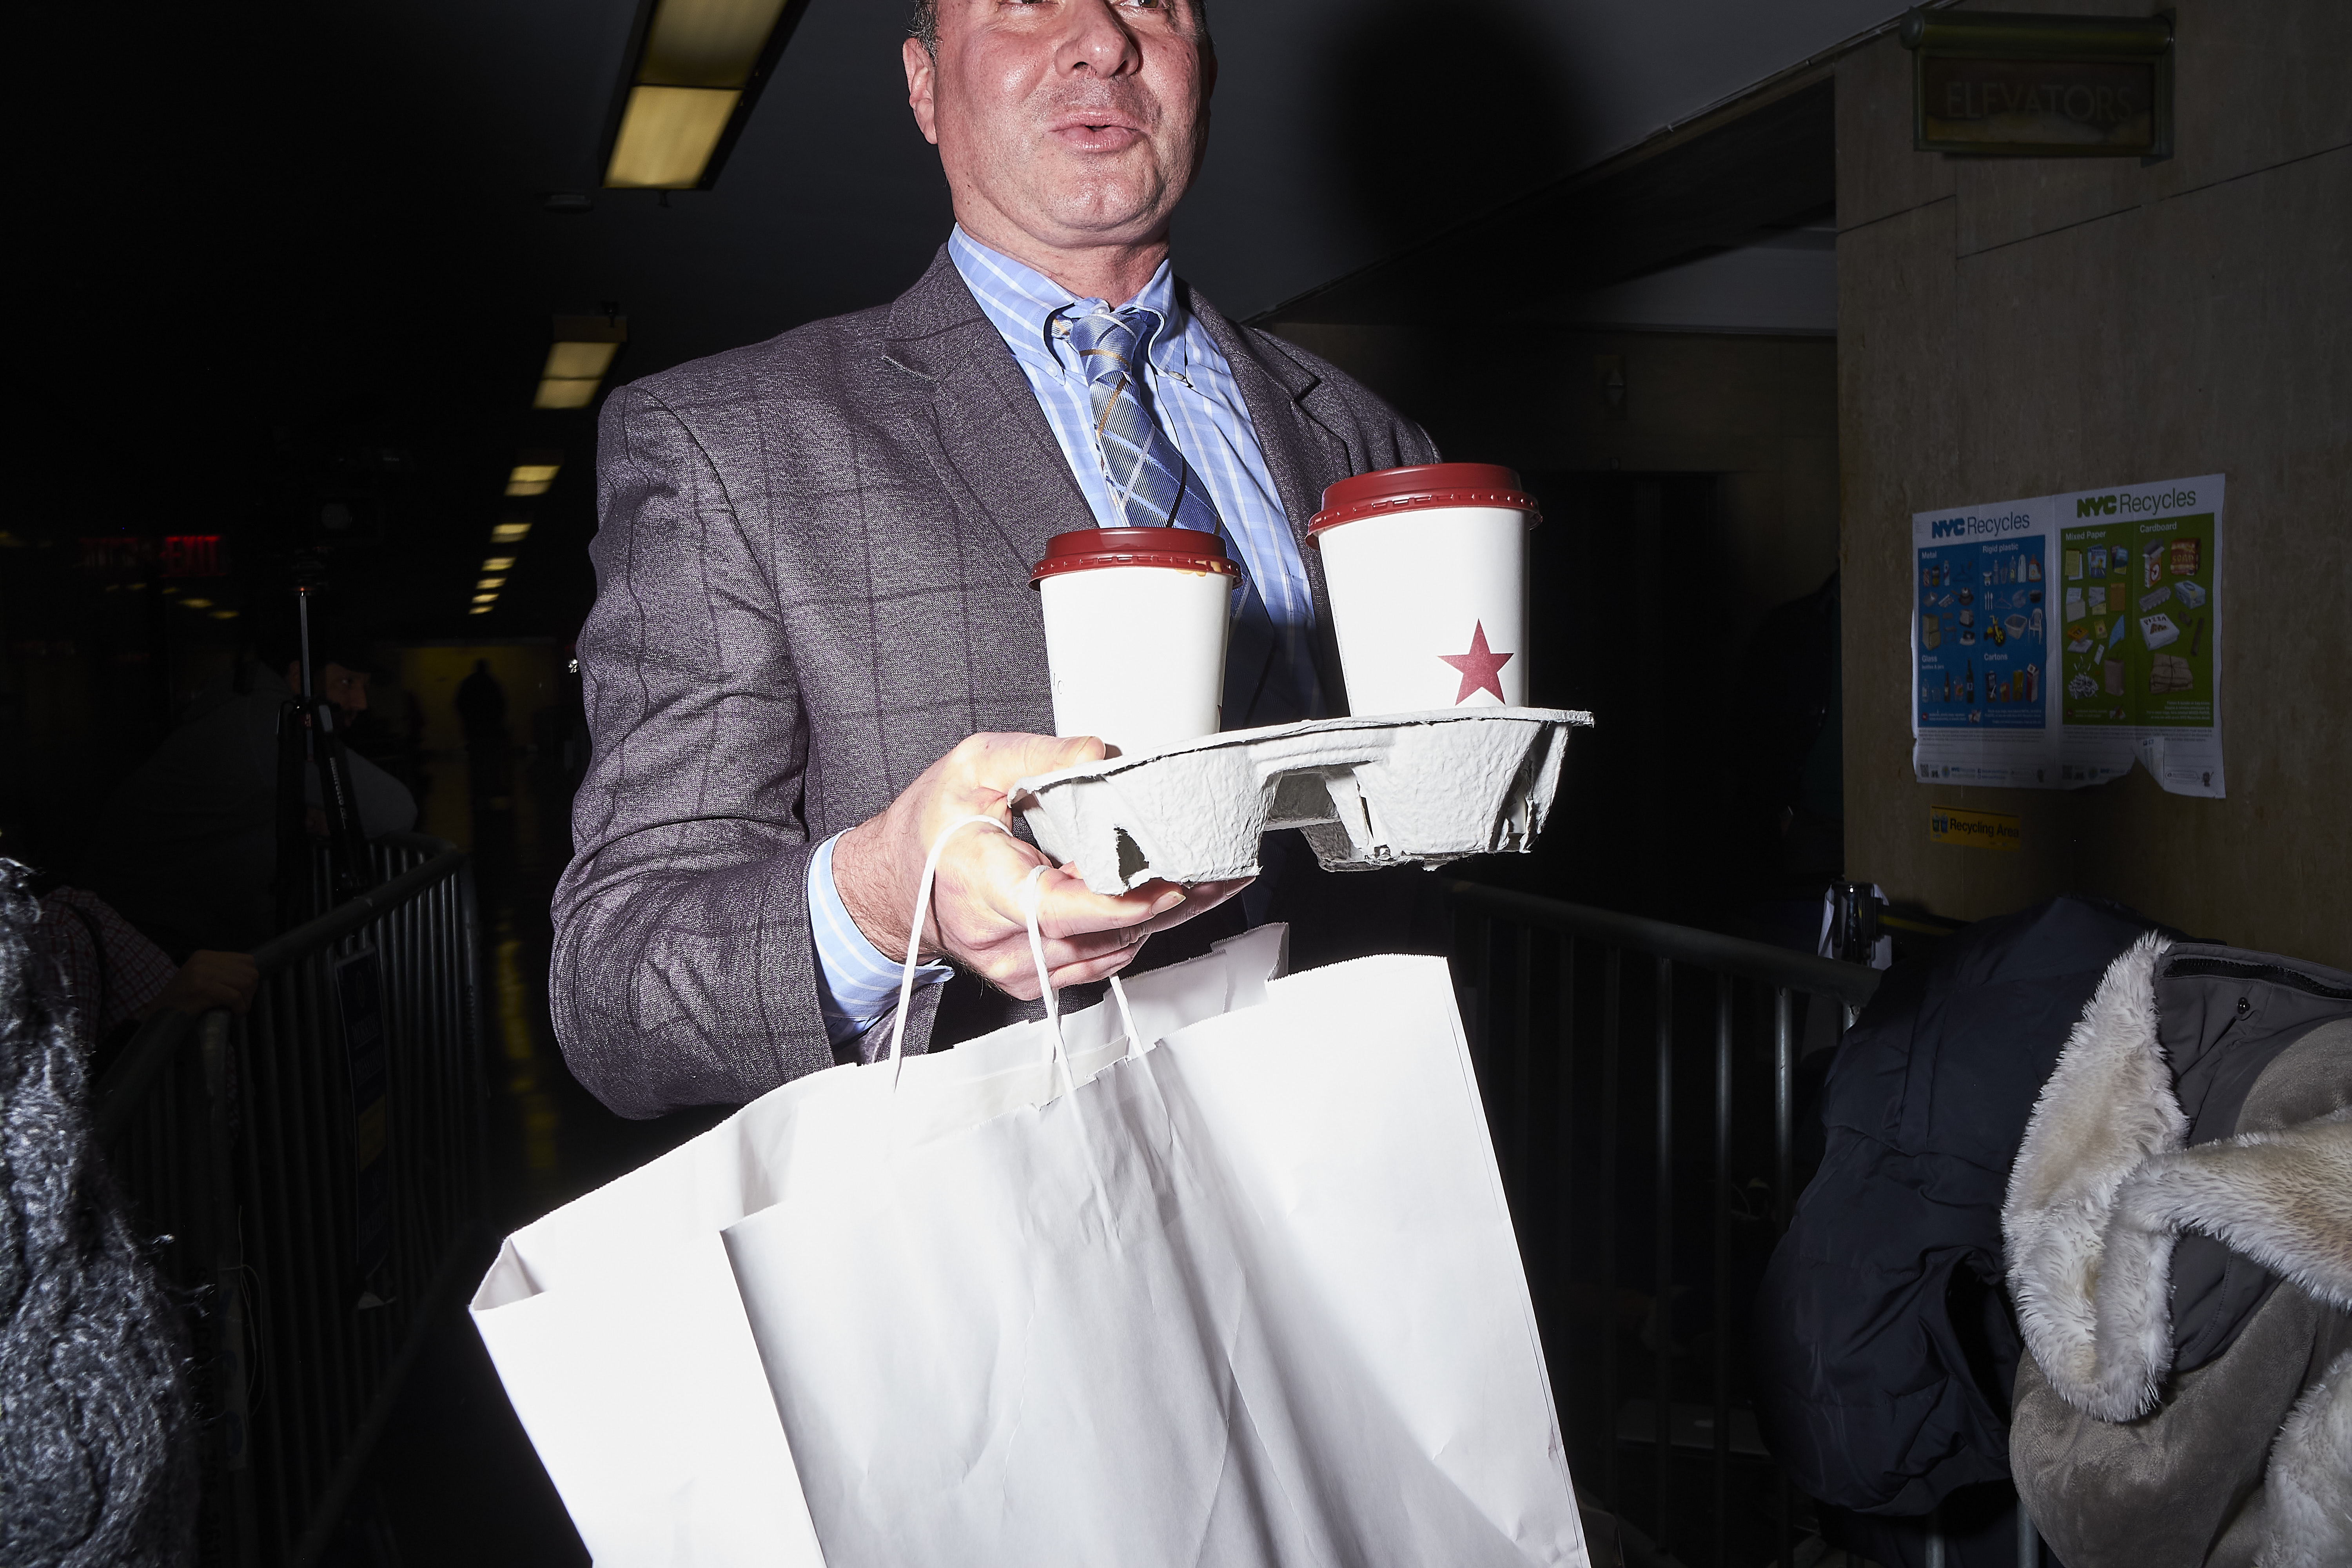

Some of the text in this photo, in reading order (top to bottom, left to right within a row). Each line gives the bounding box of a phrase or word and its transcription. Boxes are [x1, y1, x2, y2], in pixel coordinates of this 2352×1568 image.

[1945, 81, 2132, 122] ELEVATORS
[2077, 488, 2196, 518] NYC Recycles
[1931, 512, 2030, 539] NYC Recycles
[2140, 521, 2177, 533] Cardboard
[2065, 530, 2106, 541] Mixed Paper
[1922, 550, 1937, 559] Metal
[1982, 543, 2019, 555] Rigid plastic
[2143, 616, 2167, 625] PIZZA
[1922, 655, 1938, 663] Glass
[1984, 652, 2008, 661] Cartons
[1950, 818, 2019, 838] Recycling Area
